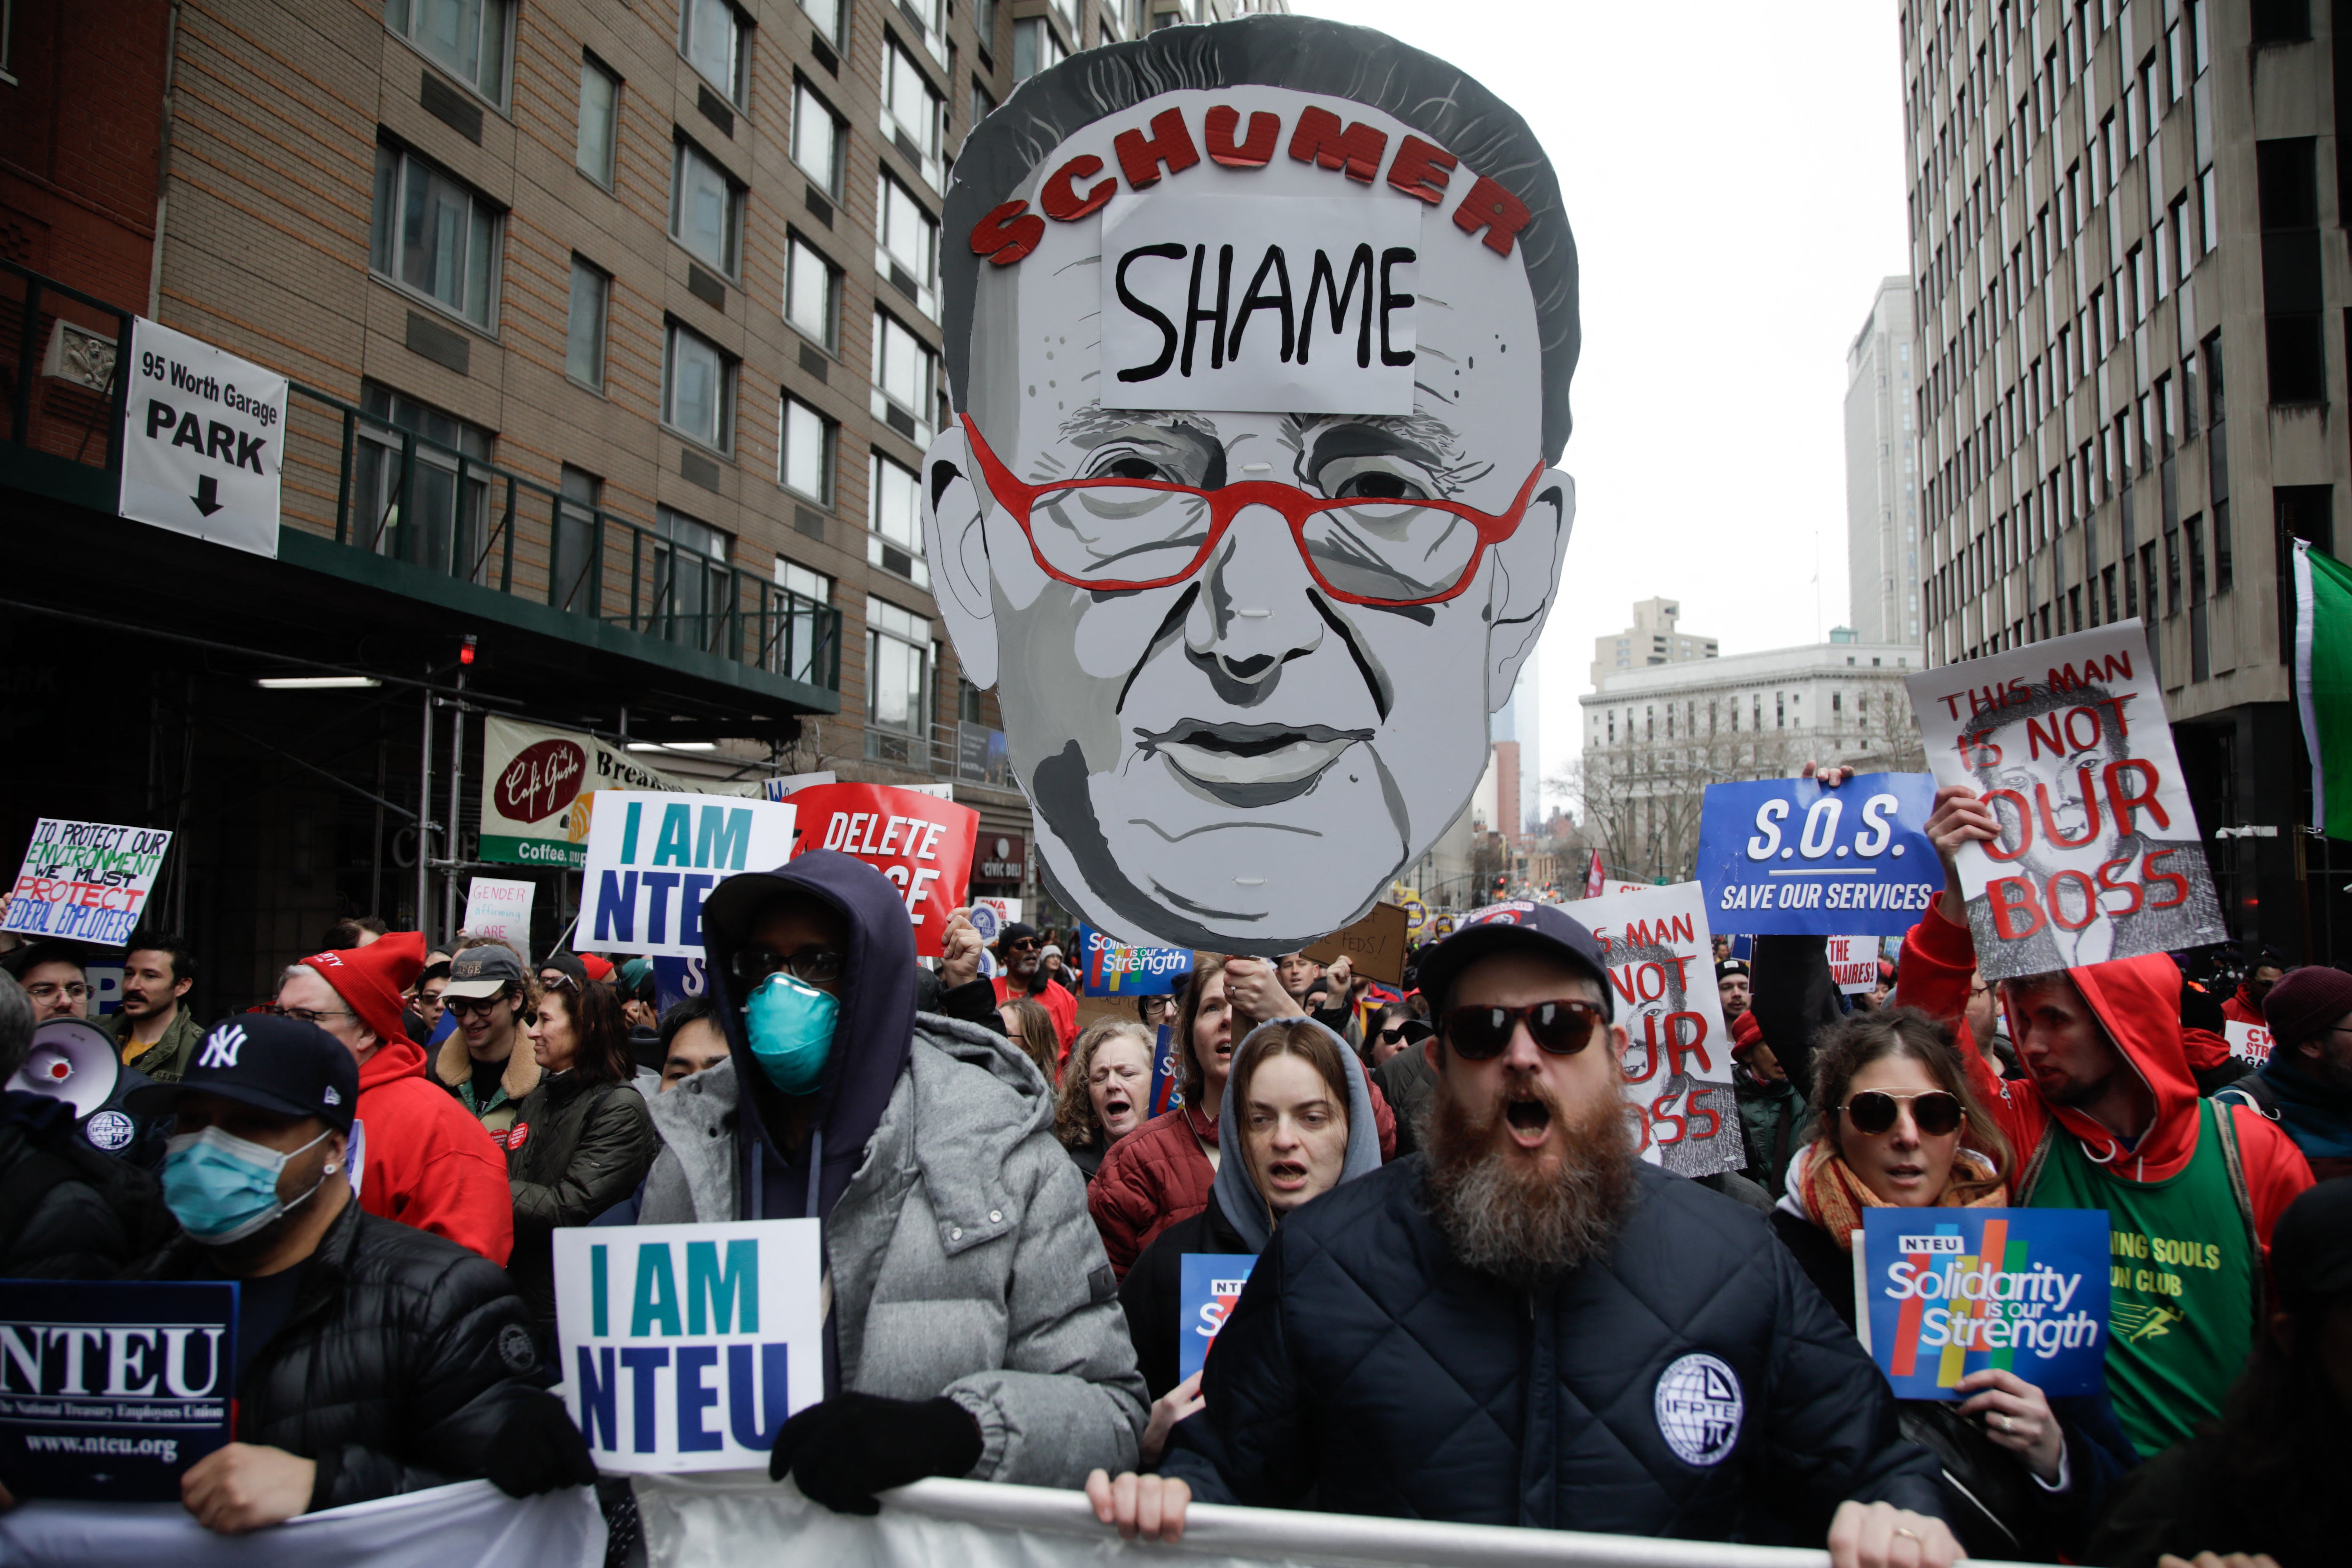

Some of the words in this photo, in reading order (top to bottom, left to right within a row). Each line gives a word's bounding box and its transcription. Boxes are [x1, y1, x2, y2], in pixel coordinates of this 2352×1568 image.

[969, 105, 1531, 265] SCHUMER
[1116, 243, 1416, 382] SHAME
[142, 351, 165, 381] 95
[170, 361, 219, 402] Worth
[224, 384, 277, 427] Garage
[146, 398, 267, 476] PARK
[1937, 676, 2031, 722] THIS
[2048, 650, 2134, 693] MAN
[1957, 728, 2003, 772] IS
[2026, 692, 2137, 761] NOT
[1747, 794, 1905, 860] S.O.S.
[1976, 758, 2170, 861] OUR
[37, 822, 57, 844] TO
[60, 824, 129, 850] PROTECT
[131, 831, 167, 855] OUR
[620, 802, 643, 865] I
[653, 803, 754, 871] AM
[823, 812, 947, 860] DELETE
[27, 842, 161, 876] ENVIRONMENT
[35, 863, 63, 879] WE
[73, 868, 137, 888] MUST
[984, 863, 1004, 877] CIVIC
[1006, 863, 1021, 877] DELI
[14, 876, 145, 911] PROTECT
[474, 885, 526, 903] GENDER
[1721, 884, 1776, 910] SAVE
[1779, 884, 1820, 909] OUR
[1825, 883, 1932, 910] SERVICES
[1986, 849, 2190, 940] BOSS
[8, 898, 55, 933] FEDERAL
[55, 903, 137, 943] EMPLOYEES
[474, 903, 521, 923] affirming
[1626, 913, 1694, 947] MAN
[475, 923, 508, 939] CARE
[1342, 931, 1386, 959] FEDS!
[1102, 951, 1186, 975] Strength
[1829, 940, 1850, 962] THE
[1905, 1238, 1958, 1251] NTEU
[2152, 1237, 2221, 1270] SOULS
[591, 1244, 608, 1337] I
[630, 1239, 759, 1337] AM
[1885, 1261, 2082, 1313] Solidarity
[2136, 1269, 2183, 1297] CLUB
[1985, 1298, 2003, 1317] is
[2008, 1301, 2046, 1318] our
[1920, 1307, 2098, 1359] Strength
[0, 1326, 225, 1398] NTEU
[578, 1343, 788, 1454] NTEU
[1665, 1399, 1737, 1419] IFPTE
